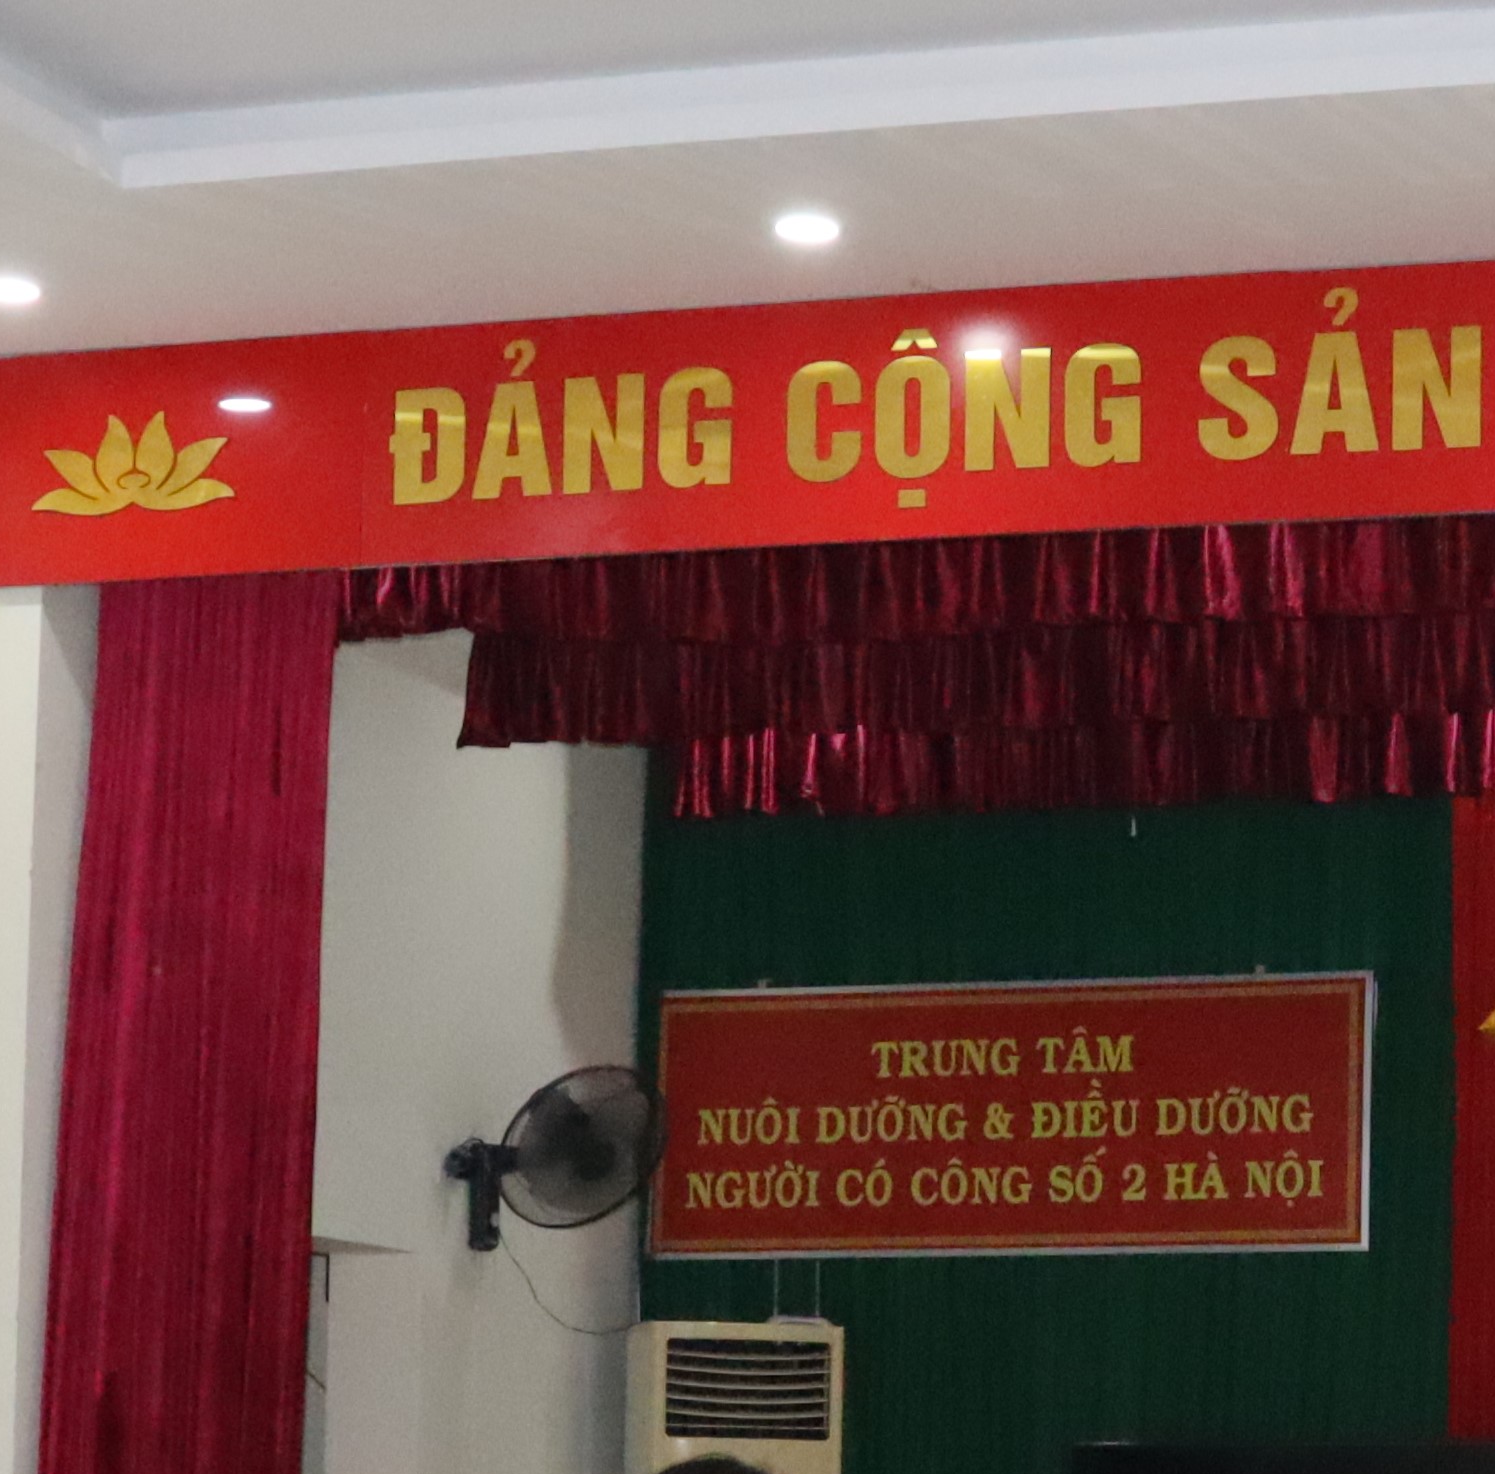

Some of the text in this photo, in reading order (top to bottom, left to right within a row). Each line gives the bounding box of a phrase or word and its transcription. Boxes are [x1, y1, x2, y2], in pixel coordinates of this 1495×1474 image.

[390, 341, 731, 504] ĐẢNG
[784, 326, 1142, 509] CỘNG
[1196, 283, 1483, 461] SẢN
[871, 1026, 1136, 1079] TRUNG TÂM
[696, 1077, 1315, 1146] NUÔI DƯỠNG & ĐIỀU DƯỠNG
[685, 1145, 1326, 1210] NGƯỜI CÓ CÔNG SỐ 2 HÀ NỘI
